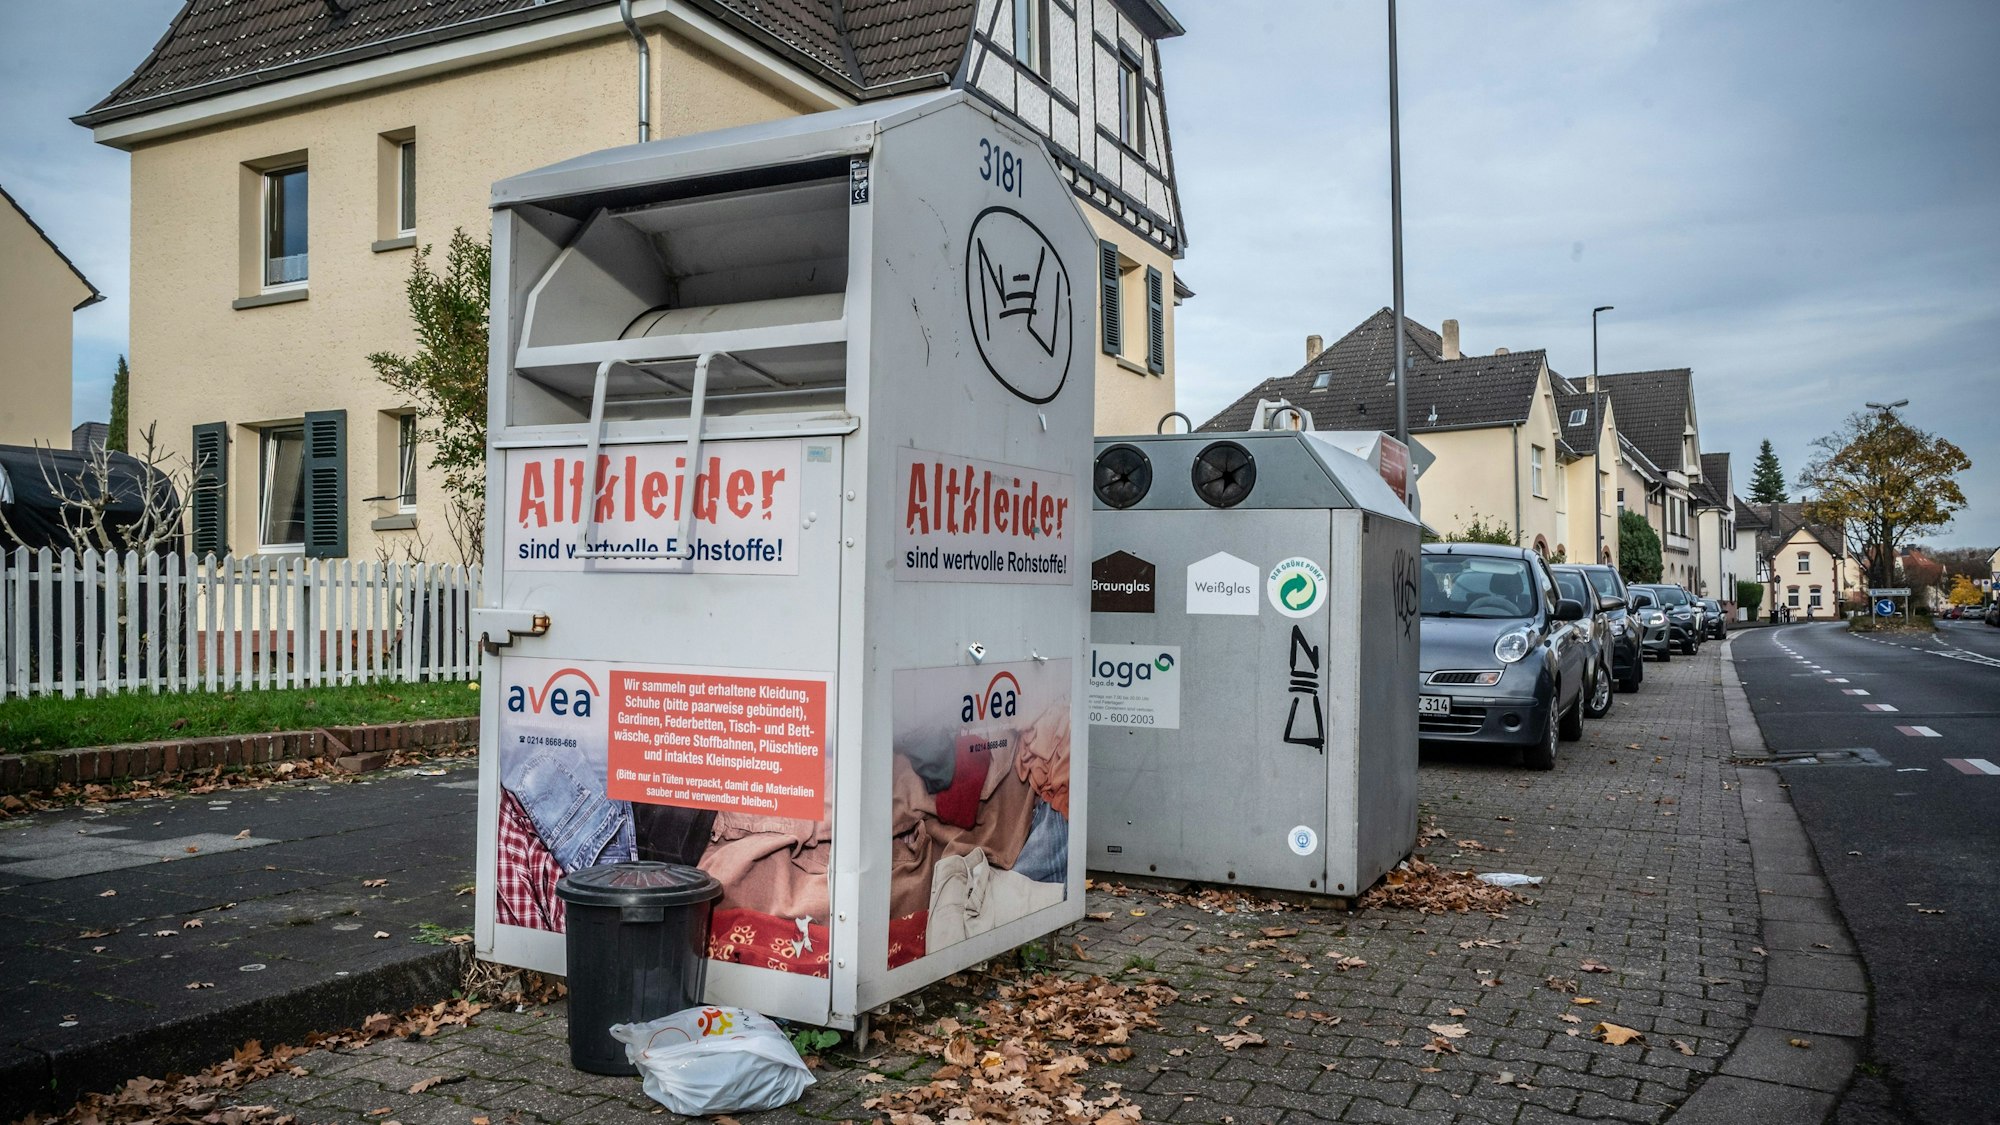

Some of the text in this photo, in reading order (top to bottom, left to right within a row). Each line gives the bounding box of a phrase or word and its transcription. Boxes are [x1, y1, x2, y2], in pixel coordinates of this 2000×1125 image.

[979, 138, 1022, 198] 3181
[906, 463, 1068, 541] Altkleider
[518, 538, 559, 560] sind
[906, 545, 1067, 574] sind wertvolle Rohstoffe!
[1270, 559, 1324, 581] DER GRÜNE PUNKT
[1091, 580, 1150, 594] Braunglas
[1195, 582, 1251, 596] Weißglas
[1092, 650, 1151, 688] loga
[507, 668, 600, 717] avea
[623, 678, 809, 703] Wir sammeln gut erhaltene Kleidung,
[961, 671, 1021, 723] avea
[625, 695, 807, 722] Schuhe (bitte paarweise gebündelt),
[1425, 698, 1448, 712] 314
[617, 711, 815, 738] Gardinen, Federbetten, Tisch- und Bett-
[1089, 712, 1102, 722] 00
[1110, 713, 1129, 723] 600
[1130, 714, 1155, 725] 2003
[526, 735, 577, 748] 0214 8668-668
[614, 729, 819, 756] wäsche, größere Stoffbahnen, Plüschtiere
[644, 749, 783, 774] und intaktes Kleinspielzeug.
[616, 768, 814, 798] (Bitte nur in Tüten verpackt, damit die Materialien
[646, 786, 778, 810] sauber und verwendbar bleiben.)
